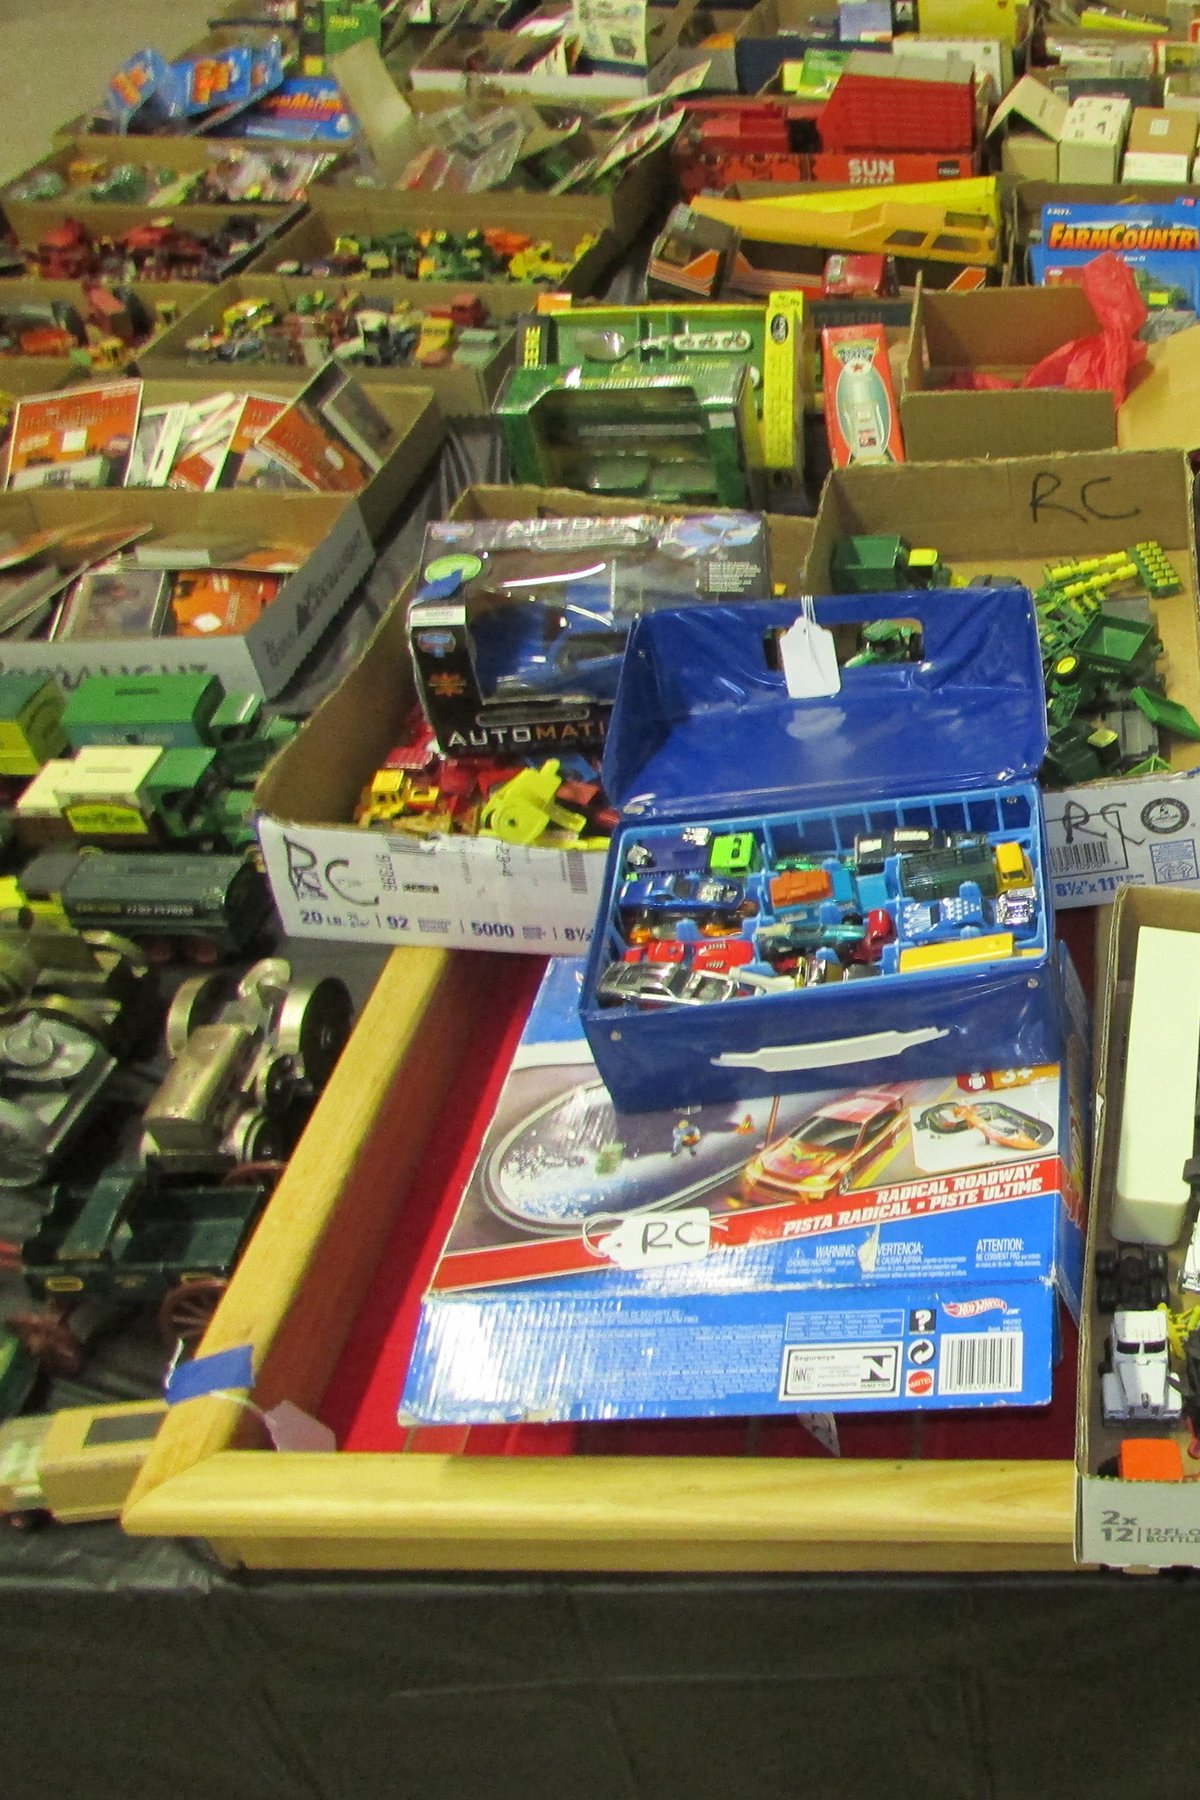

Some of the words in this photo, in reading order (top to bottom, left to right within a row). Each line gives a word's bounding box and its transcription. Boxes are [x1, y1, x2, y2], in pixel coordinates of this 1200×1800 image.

[848, 159, 895, 176] SUN
[524, 325, 541, 368] EERE
[1030, 471, 1142, 523] RC
[449, 719, 606, 748] AUTOMATI
[1063, 799, 1147, 846] RC
[283, 834, 380, 907] RC
[300, 910, 323, 926] 20
[386, 914, 410, 931] 92
[471, 921, 515, 938] 5000
[1000, 1067, 1034, 1084] 3+
[876, 1181, 949, 1204] RADICAL
[953, 1165, 1034, 1191] ROADWAY
[783, 1213, 835, 1236] PISTA
[837, 1201, 912, 1225] RADICAL
[929, 1188, 982, 1209] PISTE
[983, 1177, 1043, 1201] ULTIME
[641, 1222, 706, 1255] RC
[976, 1238, 1025, 1252] ATTENTION:
[815, 1244, 857, 1259] WARNING:
[875, 1241, 924, 1256] VERTENCIA:
[960, 1302, 978, 1317] HOT
[1100, 1510, 1138, 1526] 2x
[1100, 1527, 1134, 1543] 12
